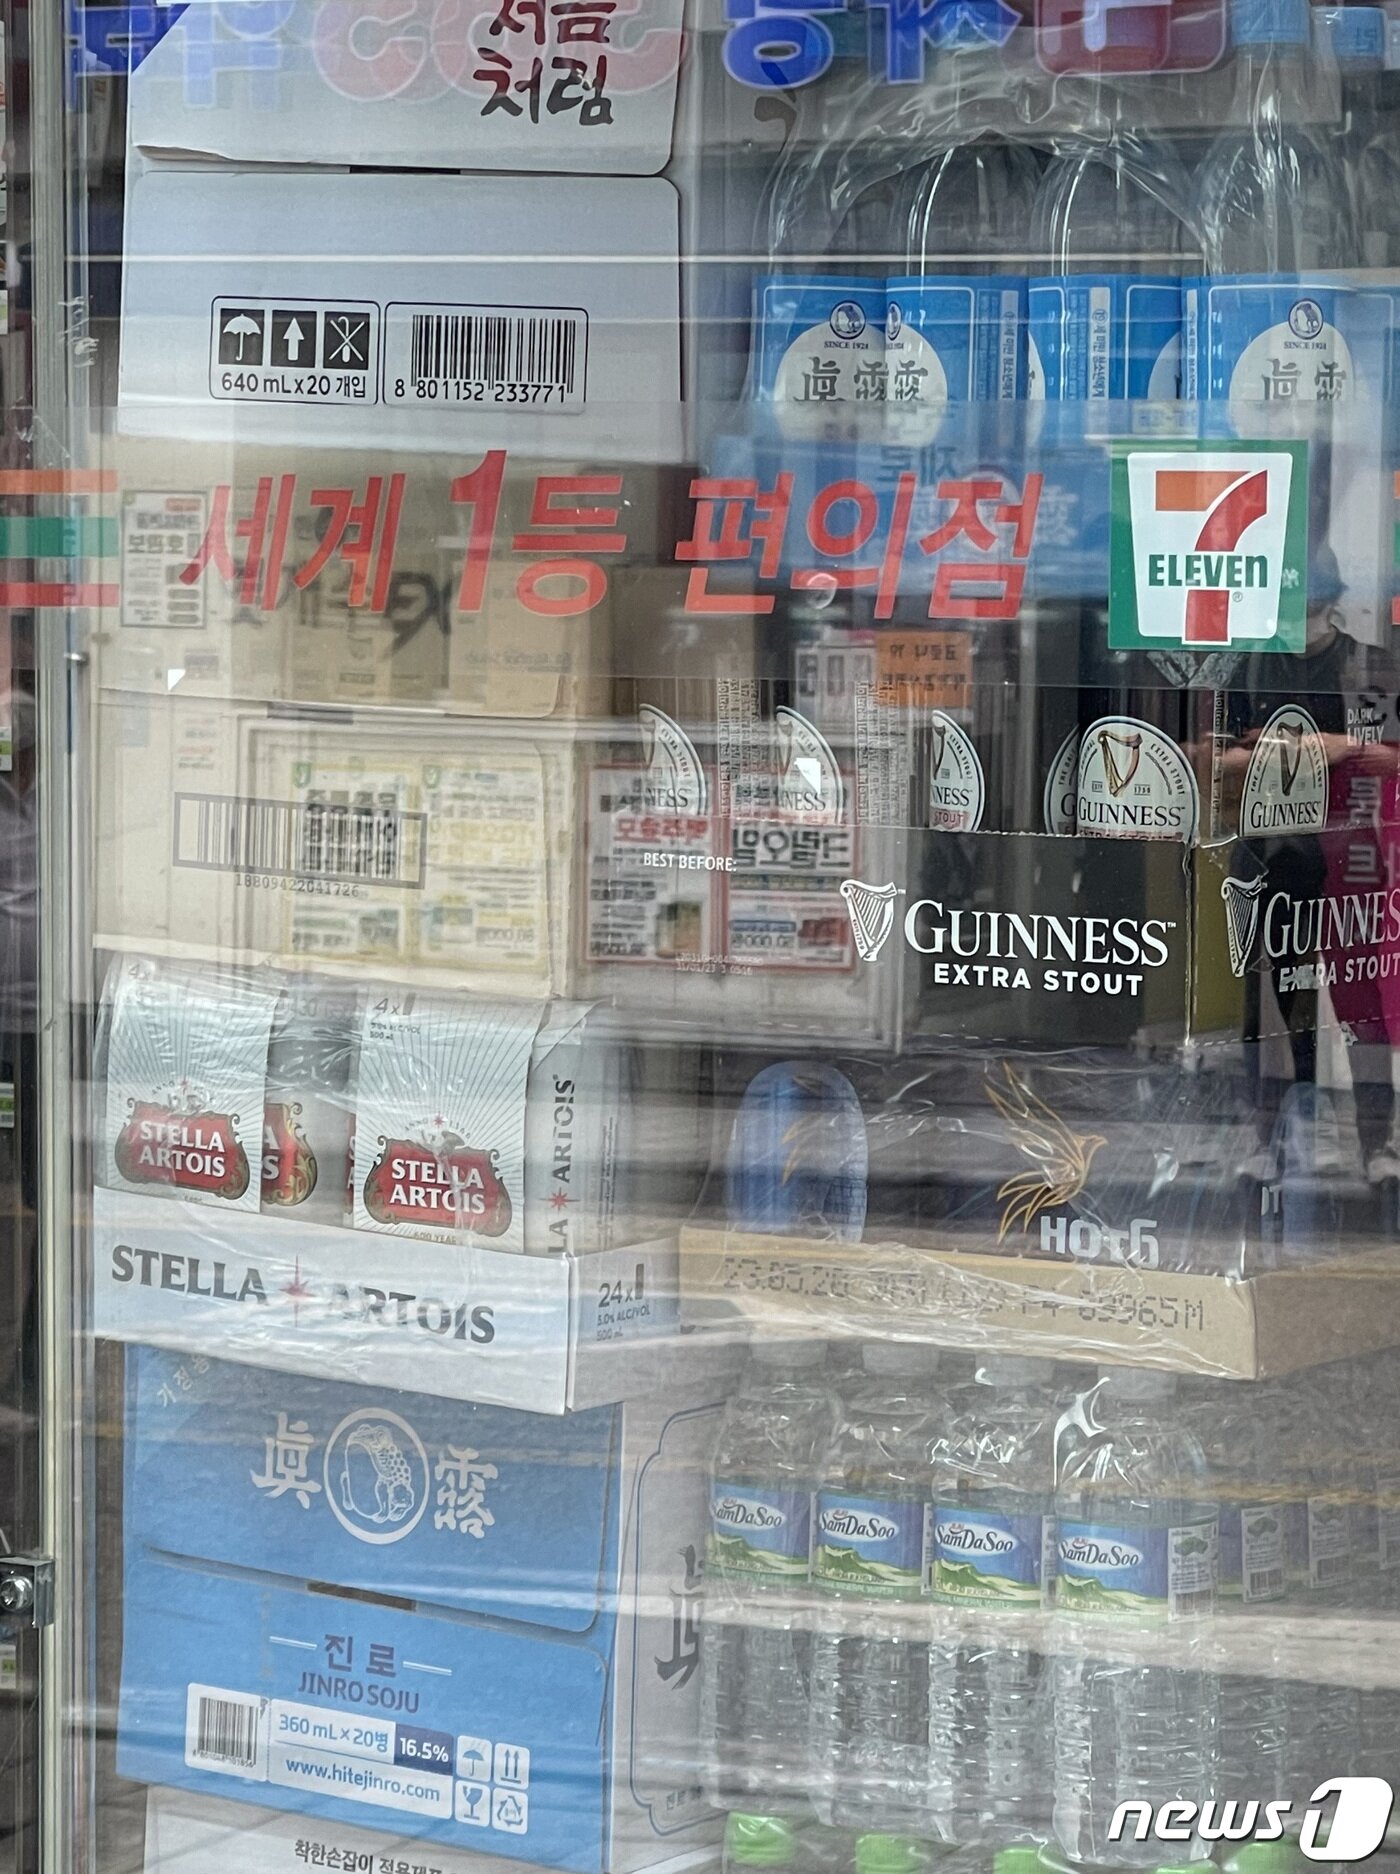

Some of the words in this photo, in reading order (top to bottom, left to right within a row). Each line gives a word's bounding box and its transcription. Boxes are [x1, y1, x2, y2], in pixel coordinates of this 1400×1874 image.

[473, 48, 614, 126] 처럼
[823, 340, 850, 350] SINCE
[1283, 340, 1307, 351] SINCE
[221, 372, 259, 394] 640
[335, 375, 366, 398] 개입
[179, 473, 406, 612] 세계
[451, 449, 627, 616] 1등
[674, 472, 1044, 620] 편의점
[1347, 708, 1373, 724] DARK
[1347, 725, 1384, 746] LIVELY
[1079, 796, 1183, 828] GUINNESS
[1250, 801, 1320, 829] GUINNESS
[643, 852, 676, 869] BEST
[678, 854, 737, 873] BEFORE:
[904, 899, 1170, 968] GUINNESS
[1263, 887, 1400, 959] GUINNES
[934, 962, 1032, 990] EXTRA
[1043, 968, 1144, 996] STOUT
[139, 1119, 226, 1153] STELLA
[552, 1078, 575, 1184] ARTOIS
[139, 1145, 226, 1178] ARTOIS
[391, 1158, 485, 1190] STELLA
[389, 1184, 486, 1216] ARTOIS
[112, 1244, 270, 1307] STELLA
[819, 1508, 896, 1539] SamDaSoo
[934, 1523, 1014, 1552] SamDaSoo
[1058, 1537, 1140, 1567] SamDaSoo
[297, 1671, 364, 1704] JINRO
[366, 1682, 420, 1715] SOJU
[279, 1713, 310, 1736] 360
[399, 1736, 450, 1764] 16.5%
[286, 1758, 440, 1803] www.hitejinro.com
